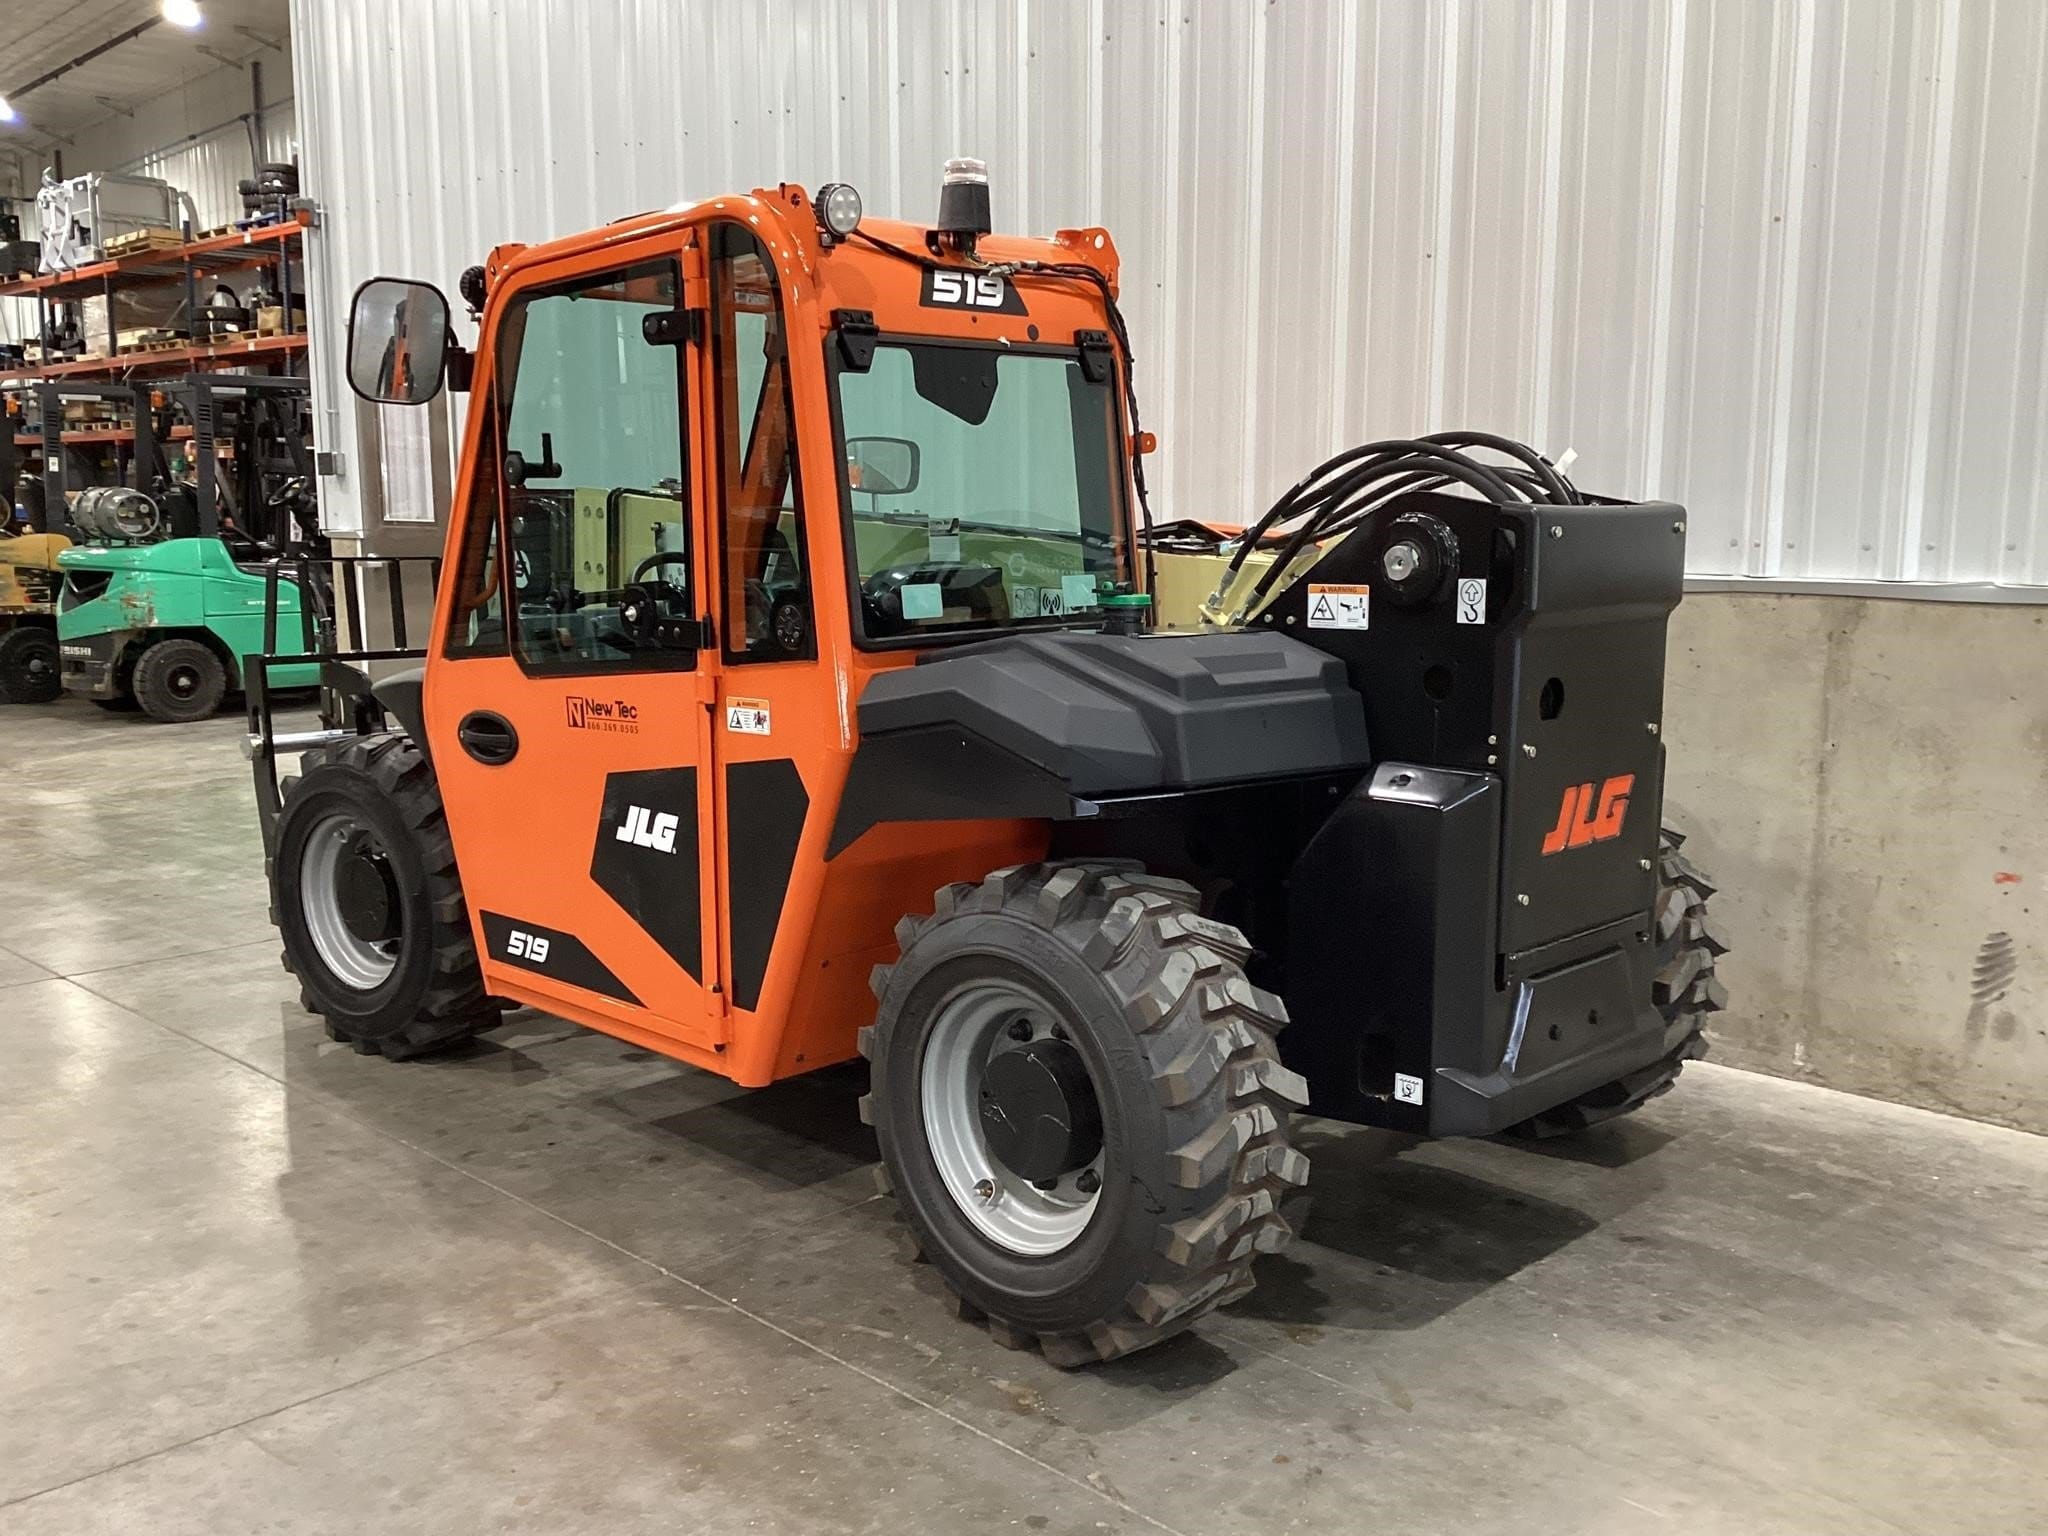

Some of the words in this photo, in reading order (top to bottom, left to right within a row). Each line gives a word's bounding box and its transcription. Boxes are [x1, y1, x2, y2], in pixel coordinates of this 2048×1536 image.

[932, 269, 1004, 307] 519
[585, 698, 613, 717] New
[615, 701, 638, 719] Tec
[615, 805, 679, 854] JLG
[1542, 774, 1635, 856] JLG
[507, 930, 550, 963] 519
